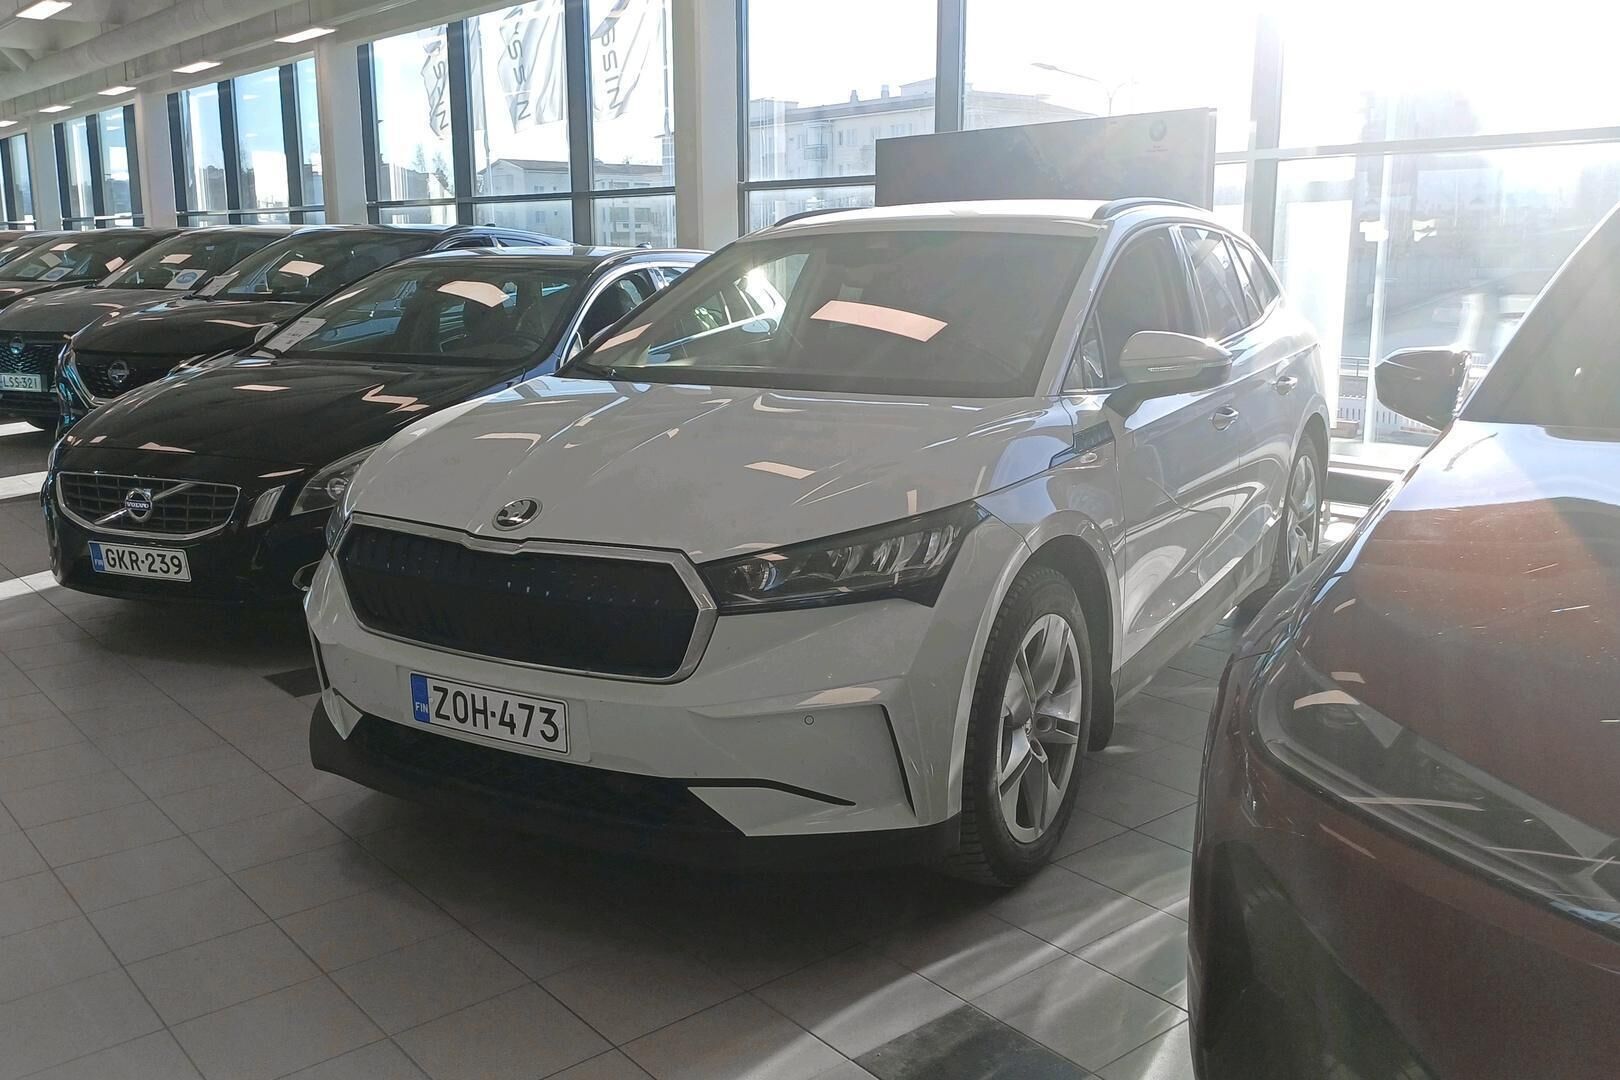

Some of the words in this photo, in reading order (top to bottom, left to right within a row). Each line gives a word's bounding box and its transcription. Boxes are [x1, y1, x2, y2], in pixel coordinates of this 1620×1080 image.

[126, 501, 150, 509] VOLVO
[105, 548, 182, 575] GKR-239
[415, 702, 429, 714] FIN
[433, 686, 559, 743] ZOH-473
